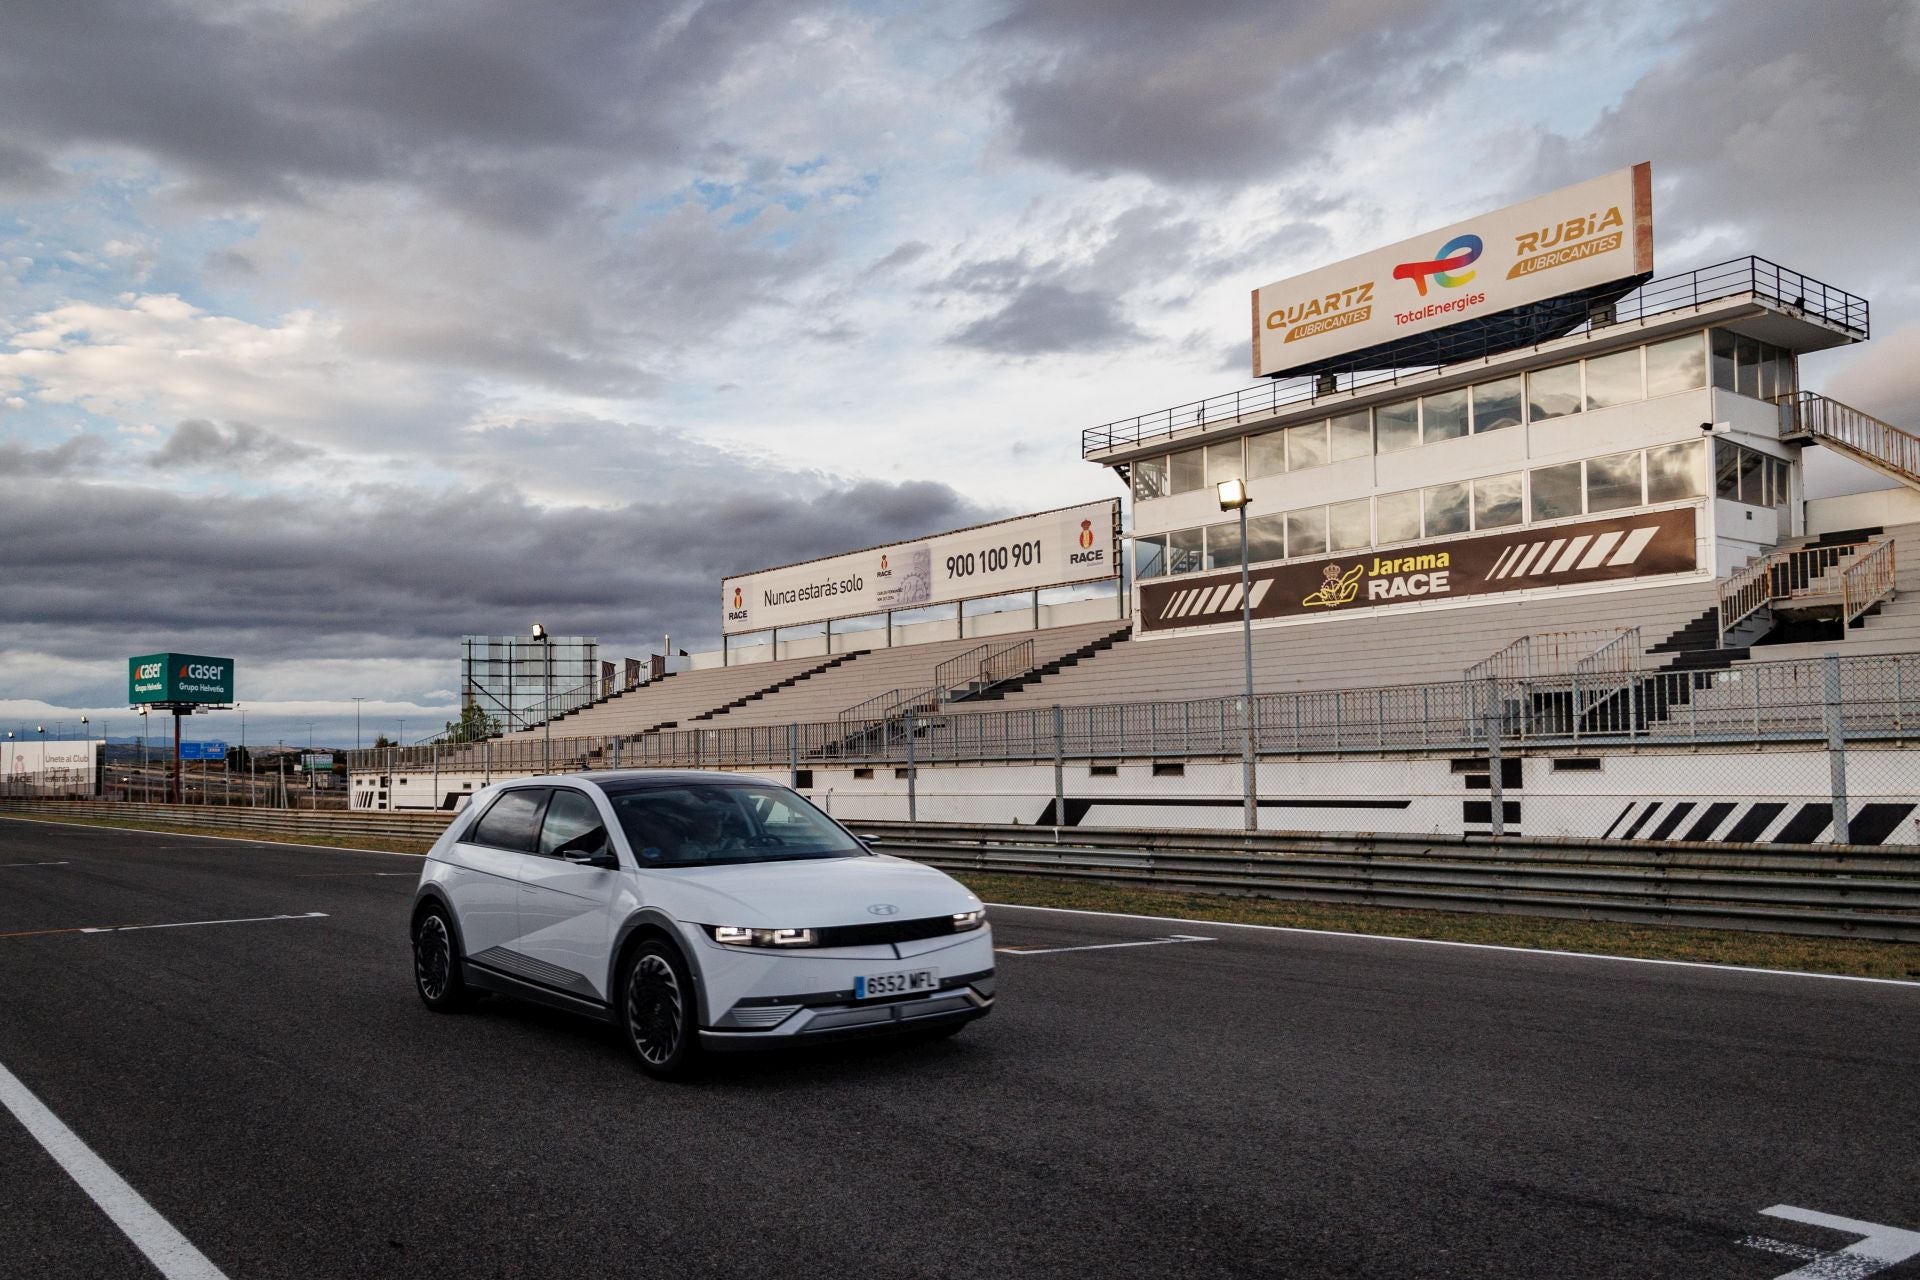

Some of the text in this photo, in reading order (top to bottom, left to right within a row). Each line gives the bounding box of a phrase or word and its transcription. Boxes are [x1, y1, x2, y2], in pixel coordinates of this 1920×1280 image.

[1519, 235, 1618, 275] LUBRICANTES
[1266, 281, 1375, 331] QUARTZ
[1394, 292, 1485, 326] TotalEnergies
[1294, 309, 1369, 341] LUBRICANTES
[946, 540, 1041, 580] 900 100 901
[1070, 549, 1104, 564] RACE
[1368, 552, 1450, 577] Jarama
[877, 570, 892, 578] RACE
[1368, 571, 1451, 601] RACE
[764, 589, 796, 607] Nunca
[798, 577, 838, 601] estarás
[840, 574, 863, 594] solo
[728, 610, 748, 620] RACE
[140, 662, 162, 679] caser
[188, 663, 224, 681] caser
[179, 682, 225, 693] Grupo Helvetia
[867, 974, 906, 994] 6552
